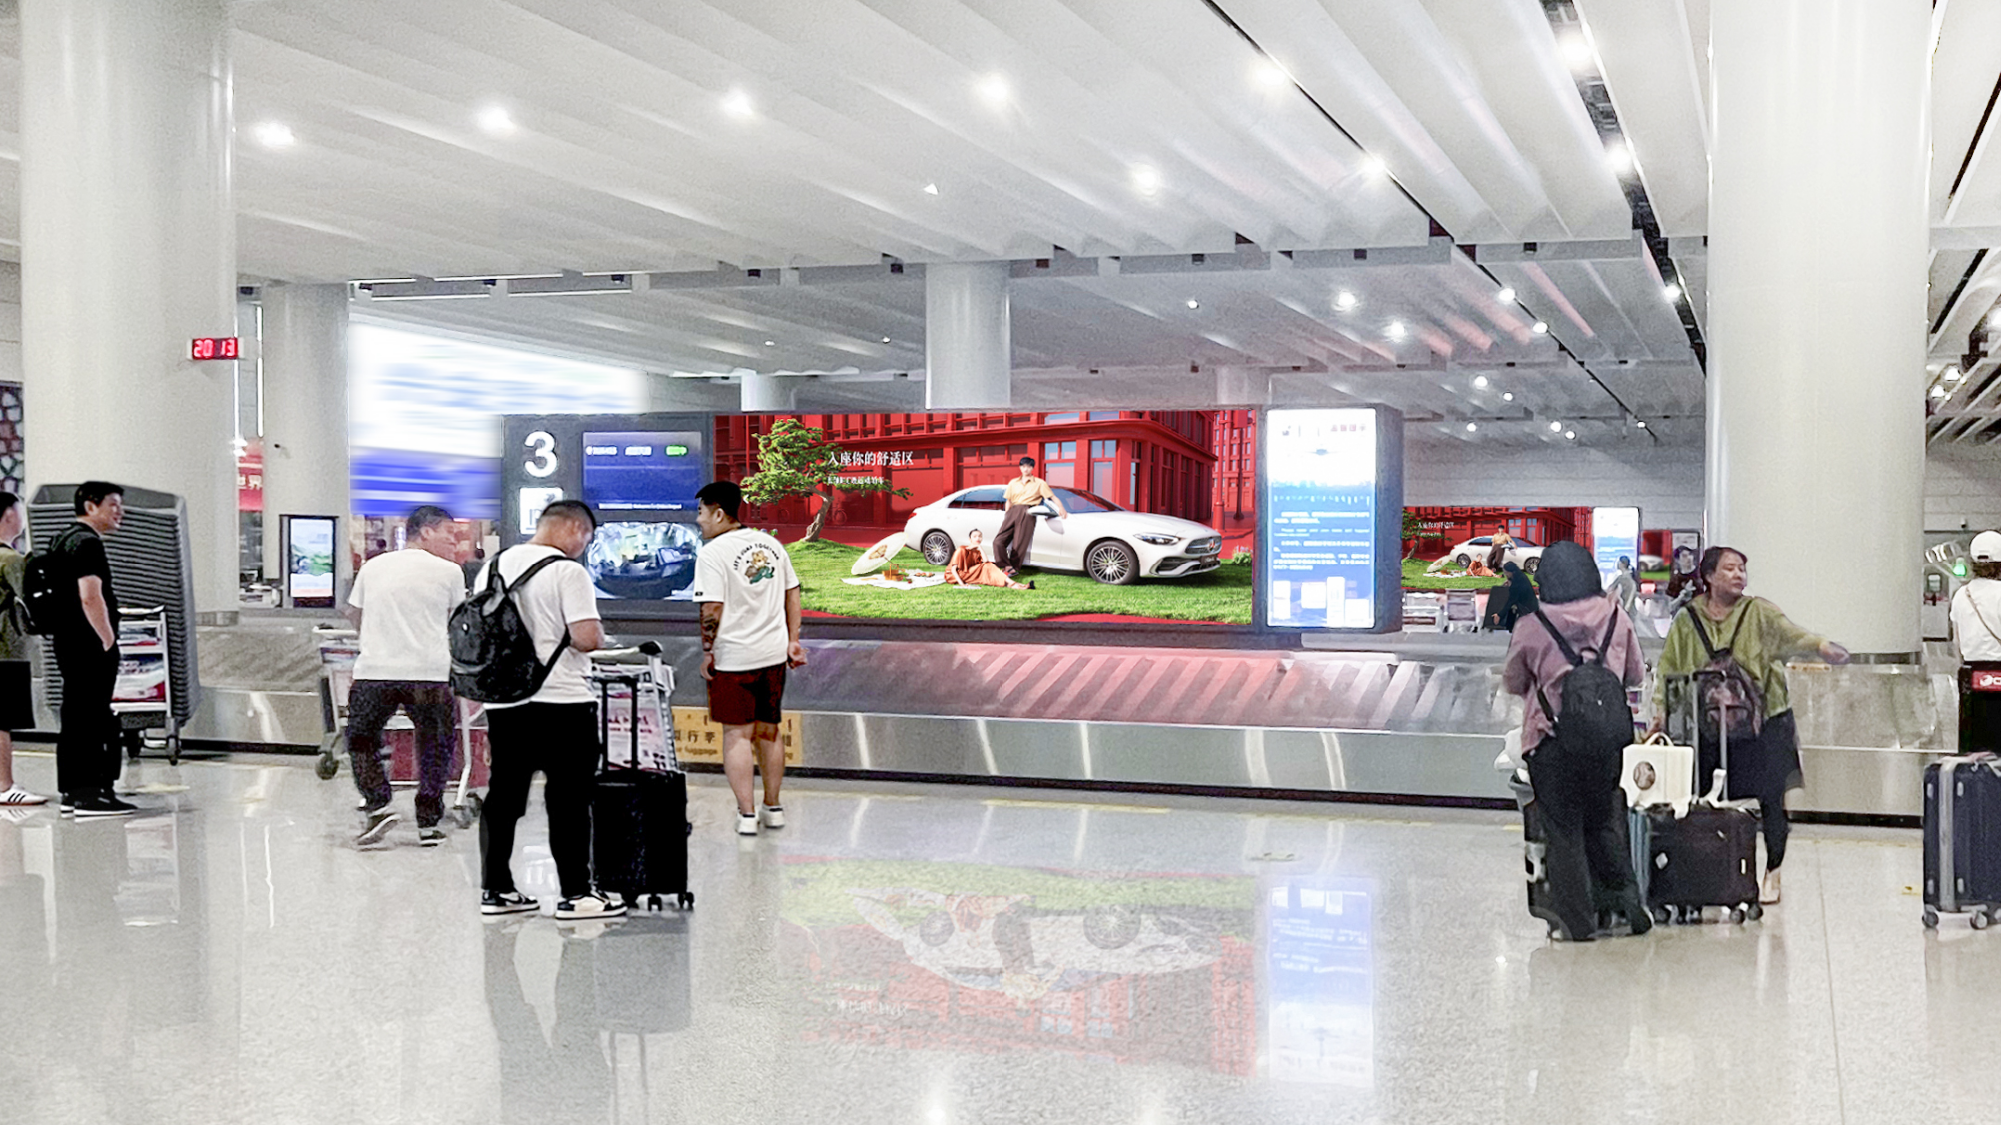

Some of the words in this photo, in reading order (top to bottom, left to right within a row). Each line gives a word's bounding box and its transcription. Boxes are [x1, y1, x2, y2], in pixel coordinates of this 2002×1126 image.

[524, 431, 558, 478] 3
[828, 451, 914, 467] 入座你的舒适区
